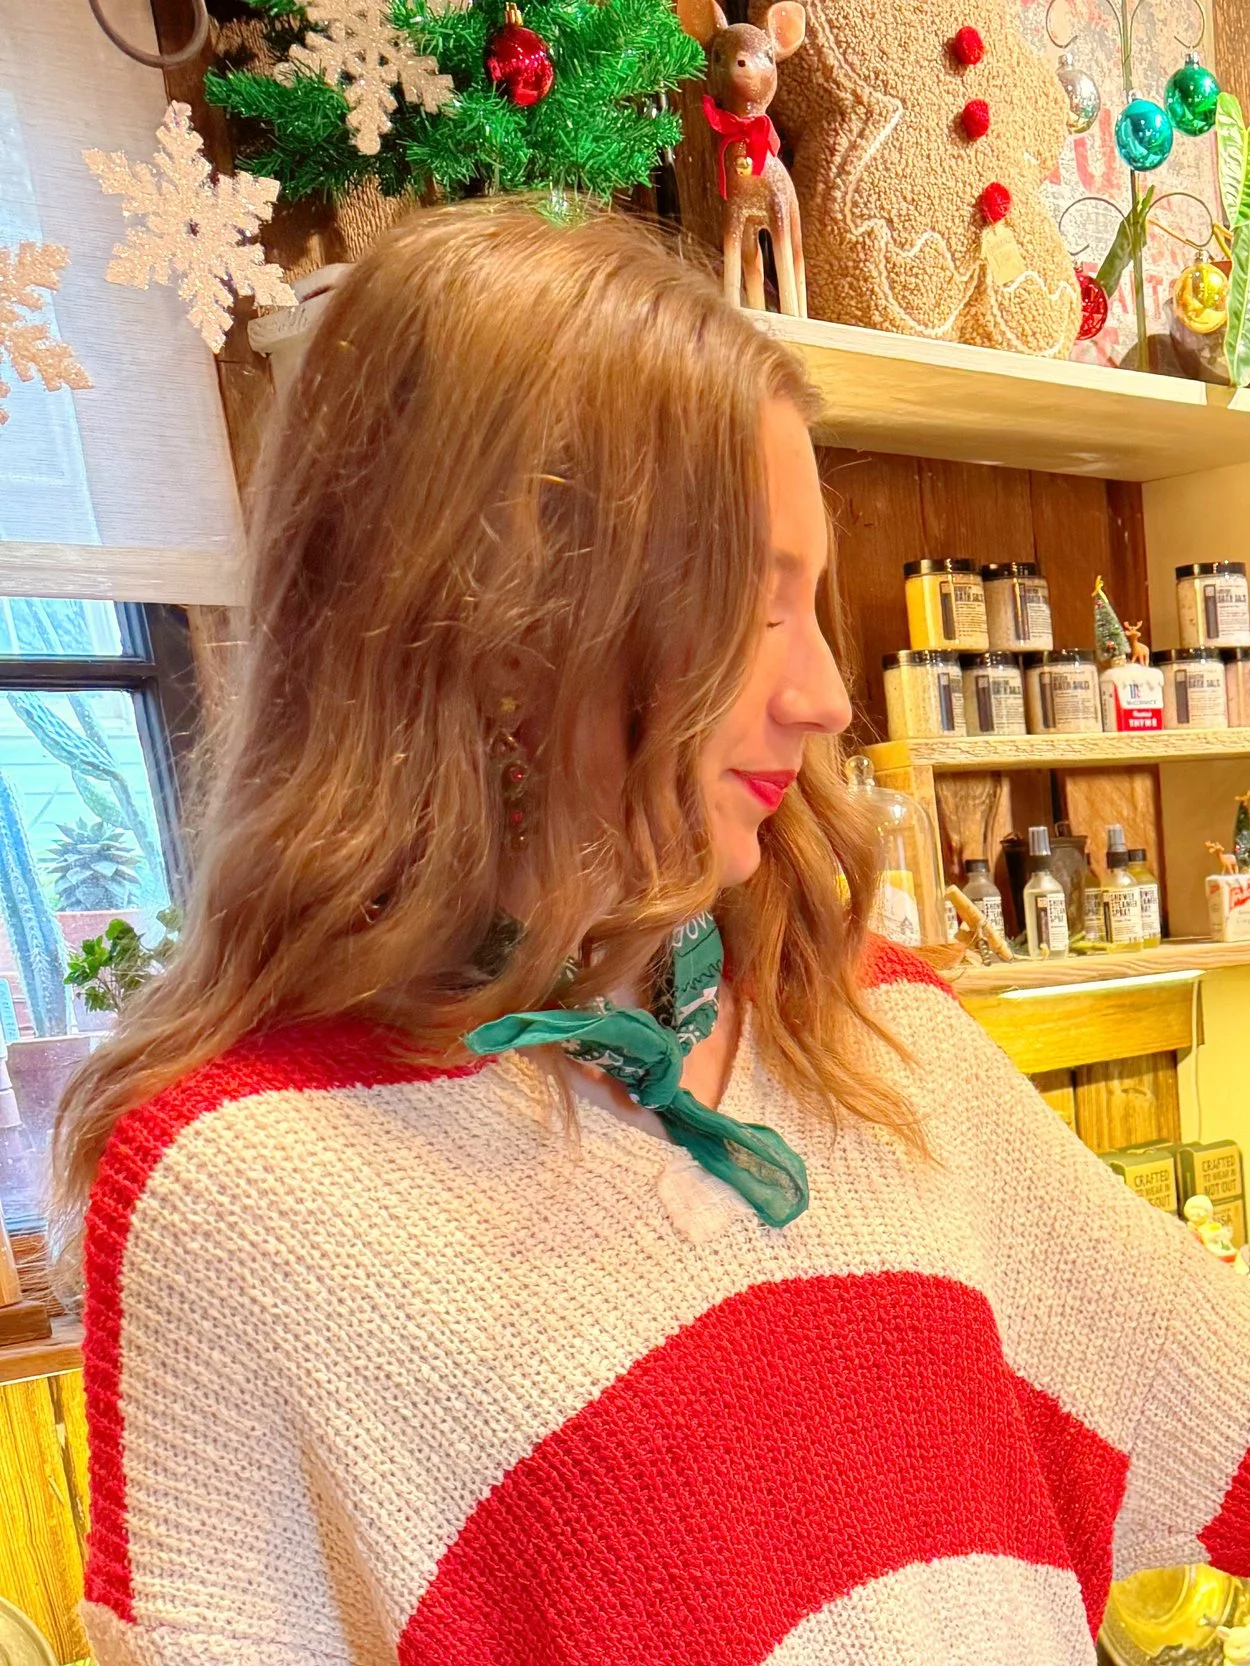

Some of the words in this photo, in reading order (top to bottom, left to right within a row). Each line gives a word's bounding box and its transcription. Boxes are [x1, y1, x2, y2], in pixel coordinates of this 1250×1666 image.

[1128, 717, 1158, 728] THYME
[1110, 892, 1135, 902] SHOWER
[1112, 908, 1131, 916] SPRAY
[1202, 1155, 1236, 1172] CRAFTED
[1133, 1169, 1170, 1188] CRAFTED
[1204, 1183, 1219, 1197] NOT
[1222, 1179, 1237, 1194] OUT
